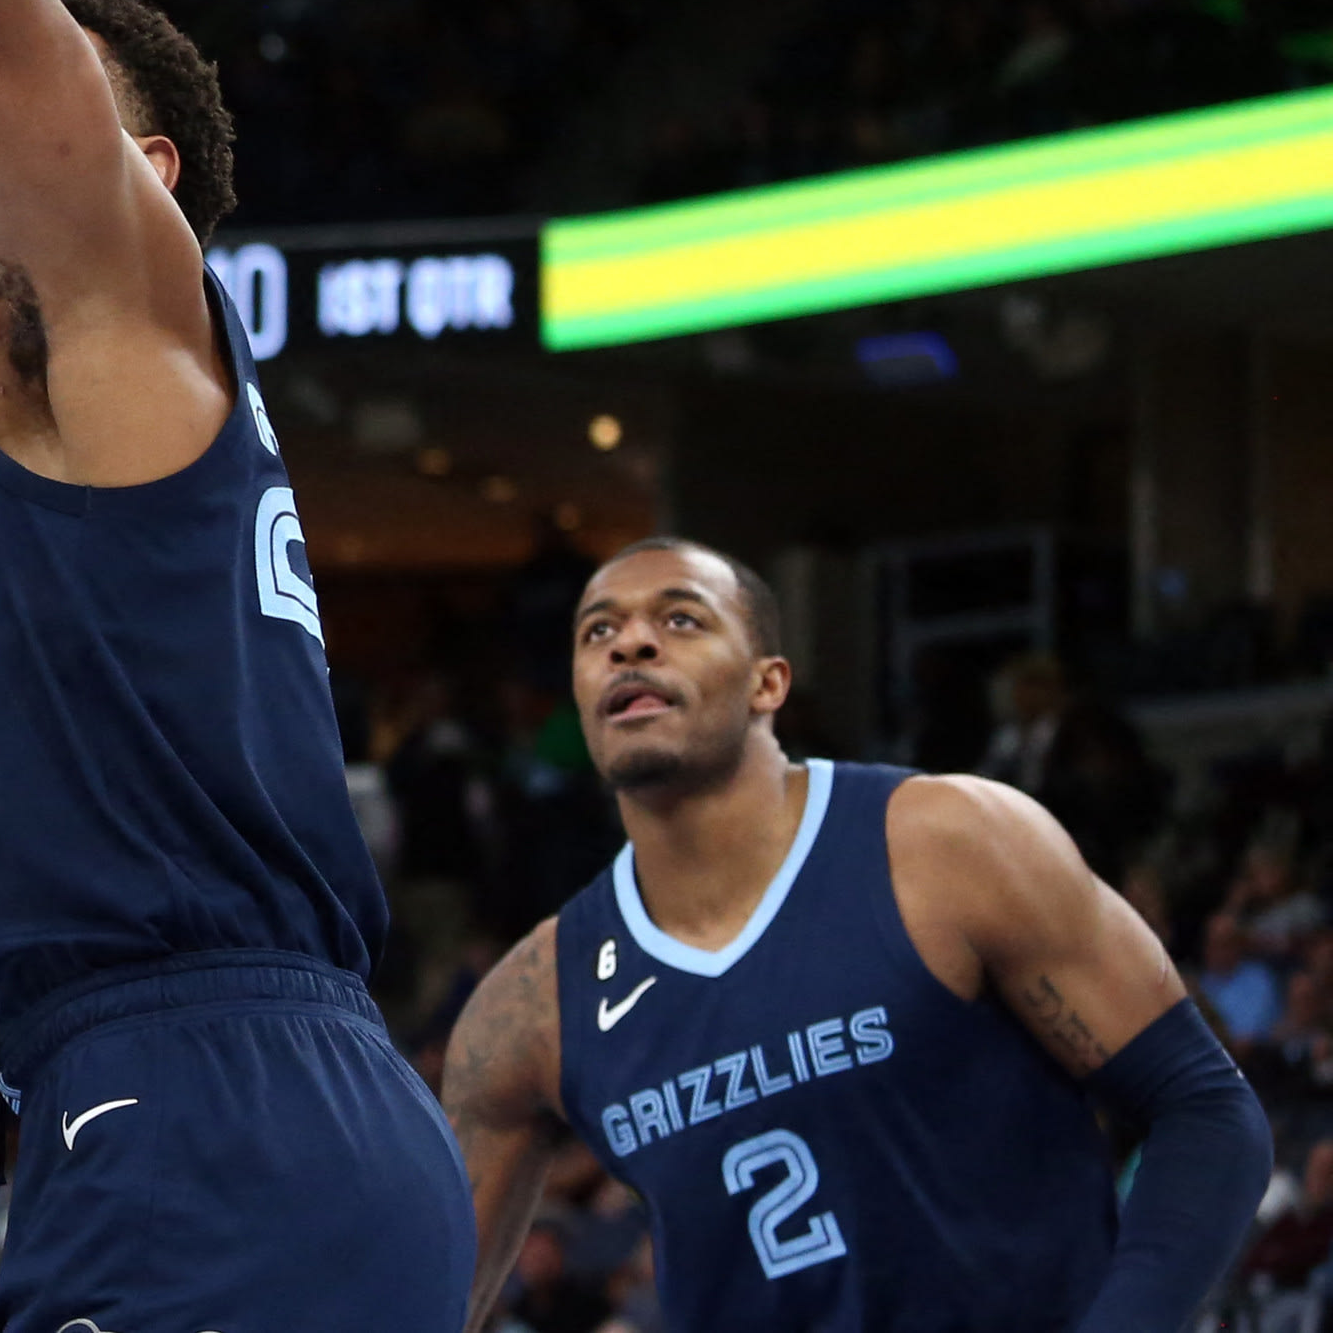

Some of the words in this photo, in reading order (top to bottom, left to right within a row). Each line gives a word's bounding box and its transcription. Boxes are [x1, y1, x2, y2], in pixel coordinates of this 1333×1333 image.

[407, 253, 514, 340] QTR
[597, 939, 617, 981] 6
[601, 1006, 895, 1158] GRIZZLIES
[721, 1129, 847, 1282] 2
